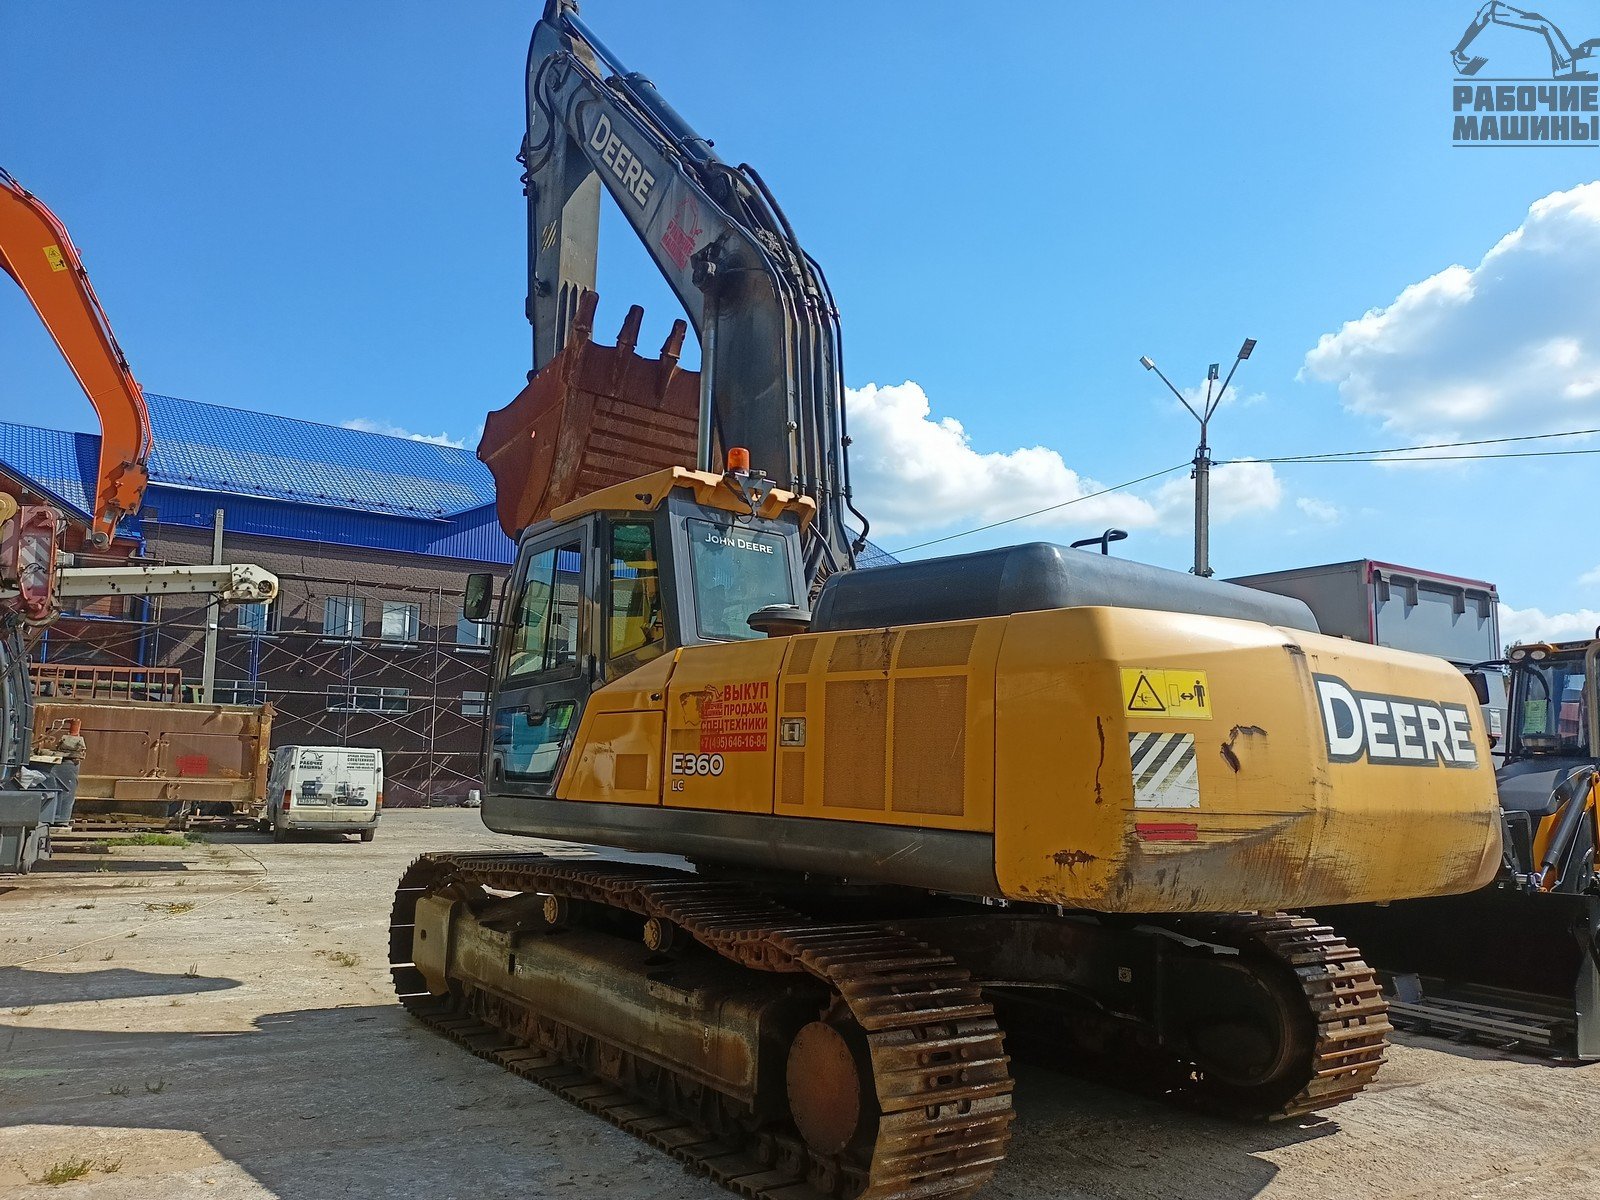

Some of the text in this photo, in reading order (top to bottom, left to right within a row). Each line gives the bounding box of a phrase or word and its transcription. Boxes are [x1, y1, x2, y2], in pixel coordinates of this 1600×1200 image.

[590, 113, 656, 207] DEERE
[705, 533, 774, 554] JOHN DEERE
[723, 682, 769, 701] ВЫКУП
[723, 702, 768, 717] ПРОДАЖА
[701, 717, 768, 733] СПЕЦТЕХНИКИ
[1317, 680, 1477, 763] DEERE
[671, 753, 724, 776] E360
[672, 780, 684, 791] LC
